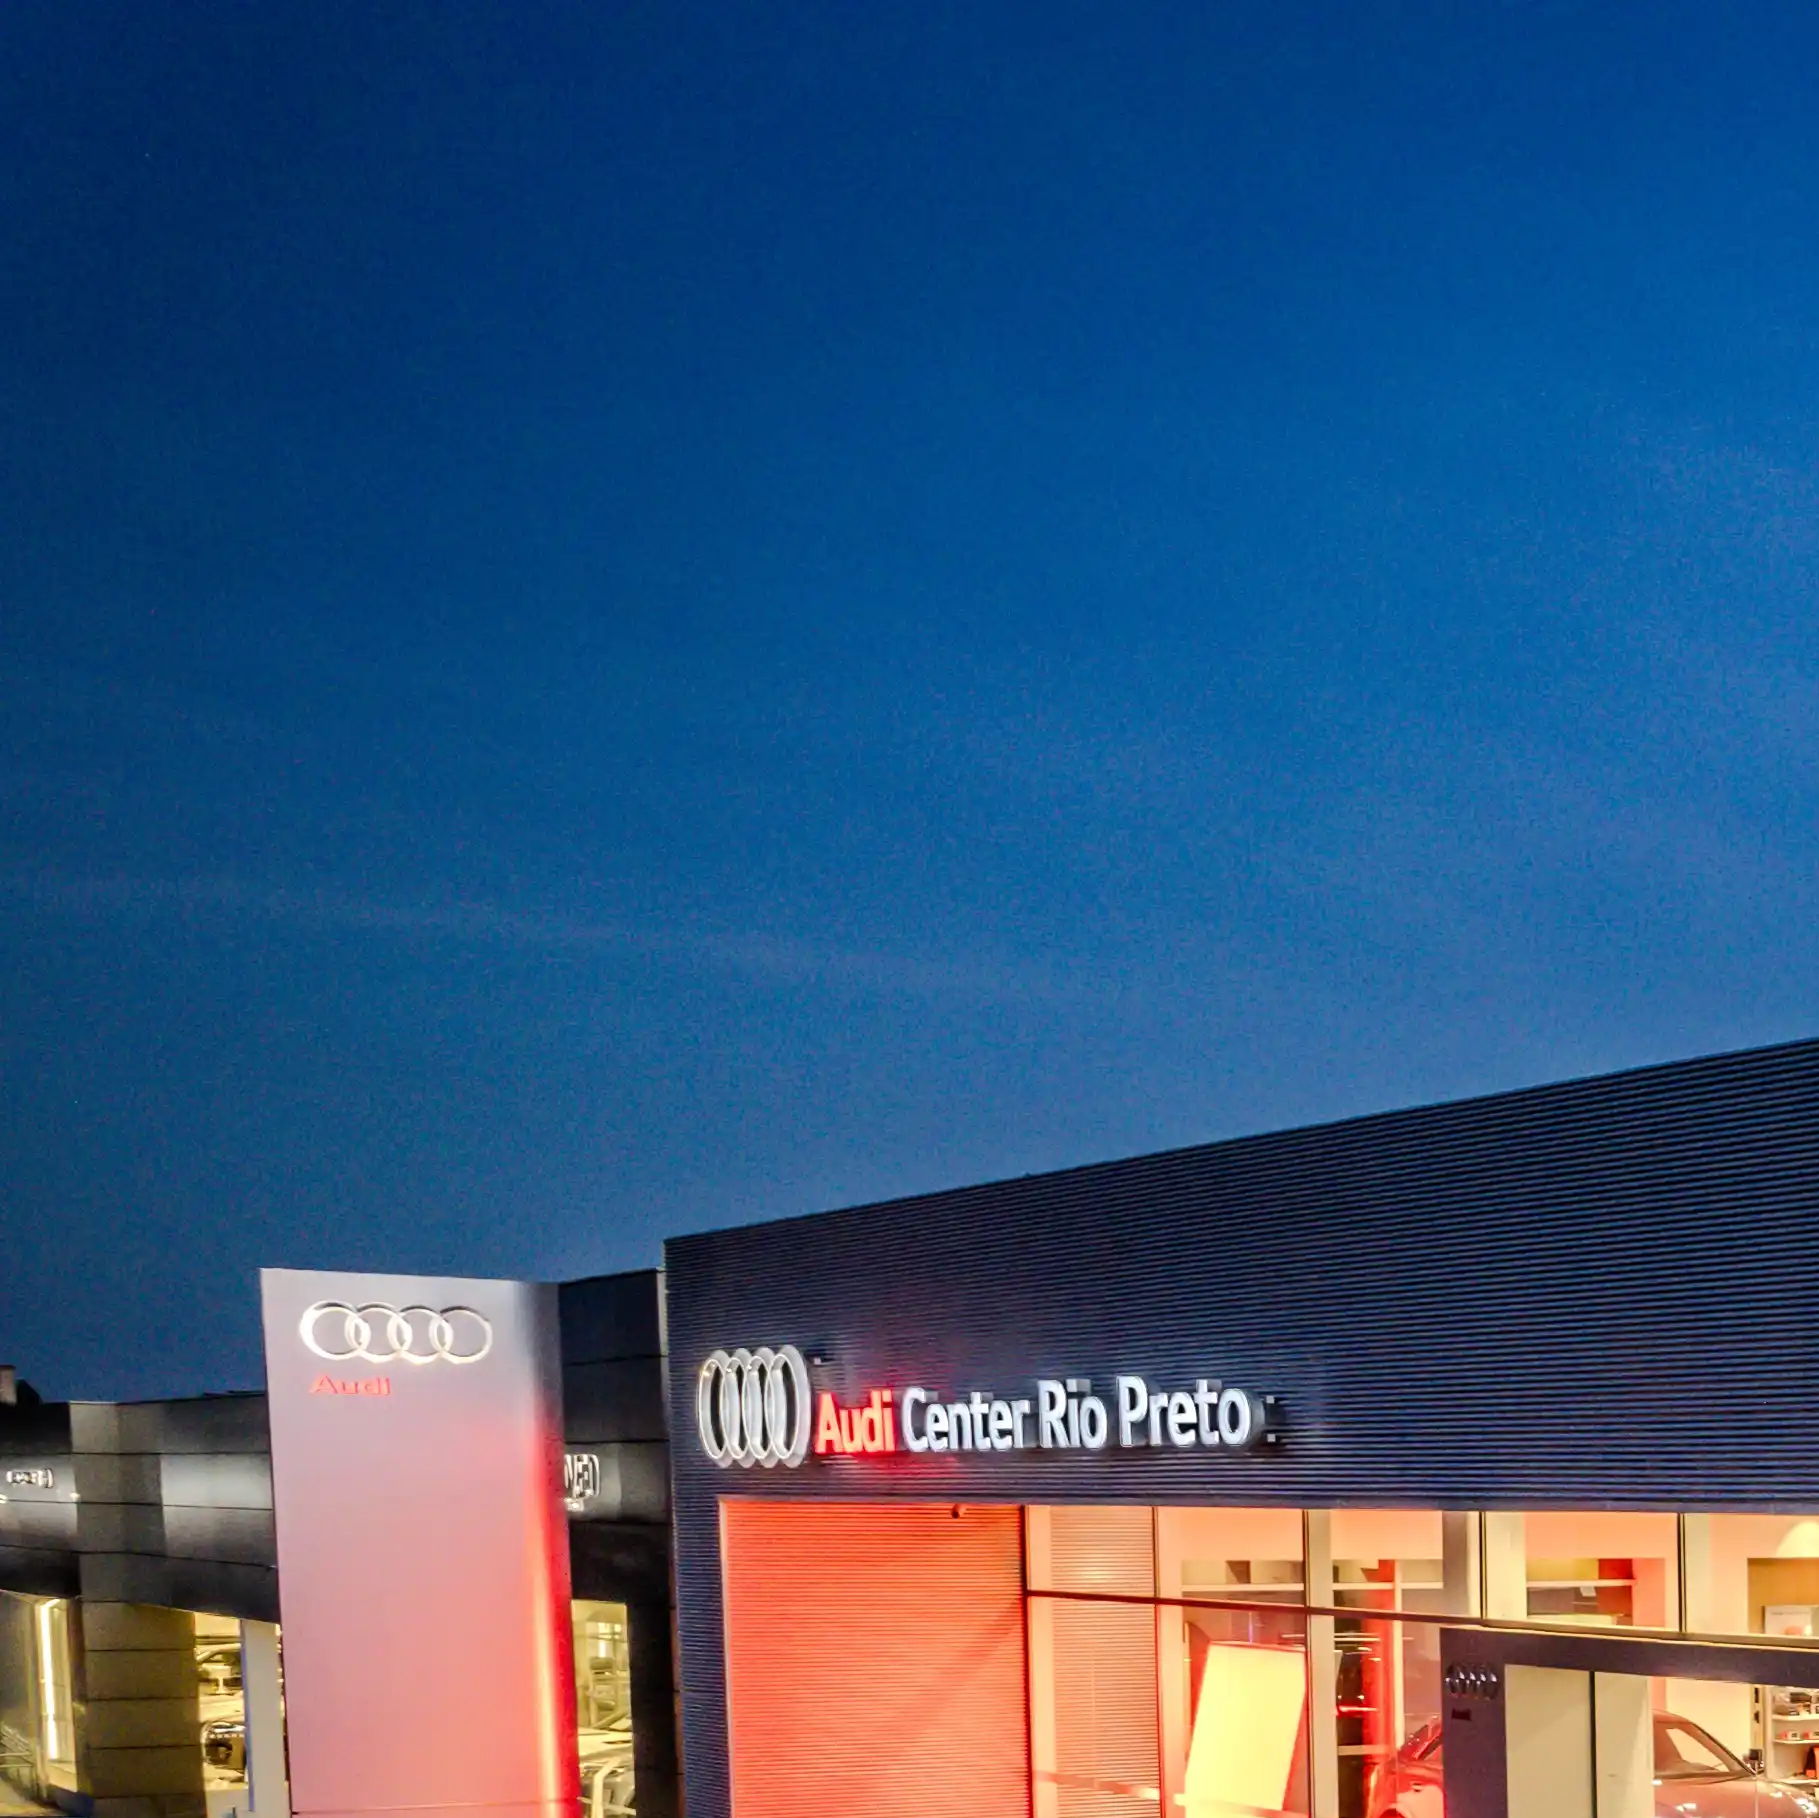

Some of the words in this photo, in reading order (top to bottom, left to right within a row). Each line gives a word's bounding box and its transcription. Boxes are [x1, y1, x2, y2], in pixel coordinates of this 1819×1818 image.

[308, 1373, 391, 1396] Audi
[814, 1388, 895, 1453] Audi
[902, 1386, 1031, 1453] Center
[1037, 1379, 1108, 1449] Rio
[1116, 1375, 1254, 1448] Preto
